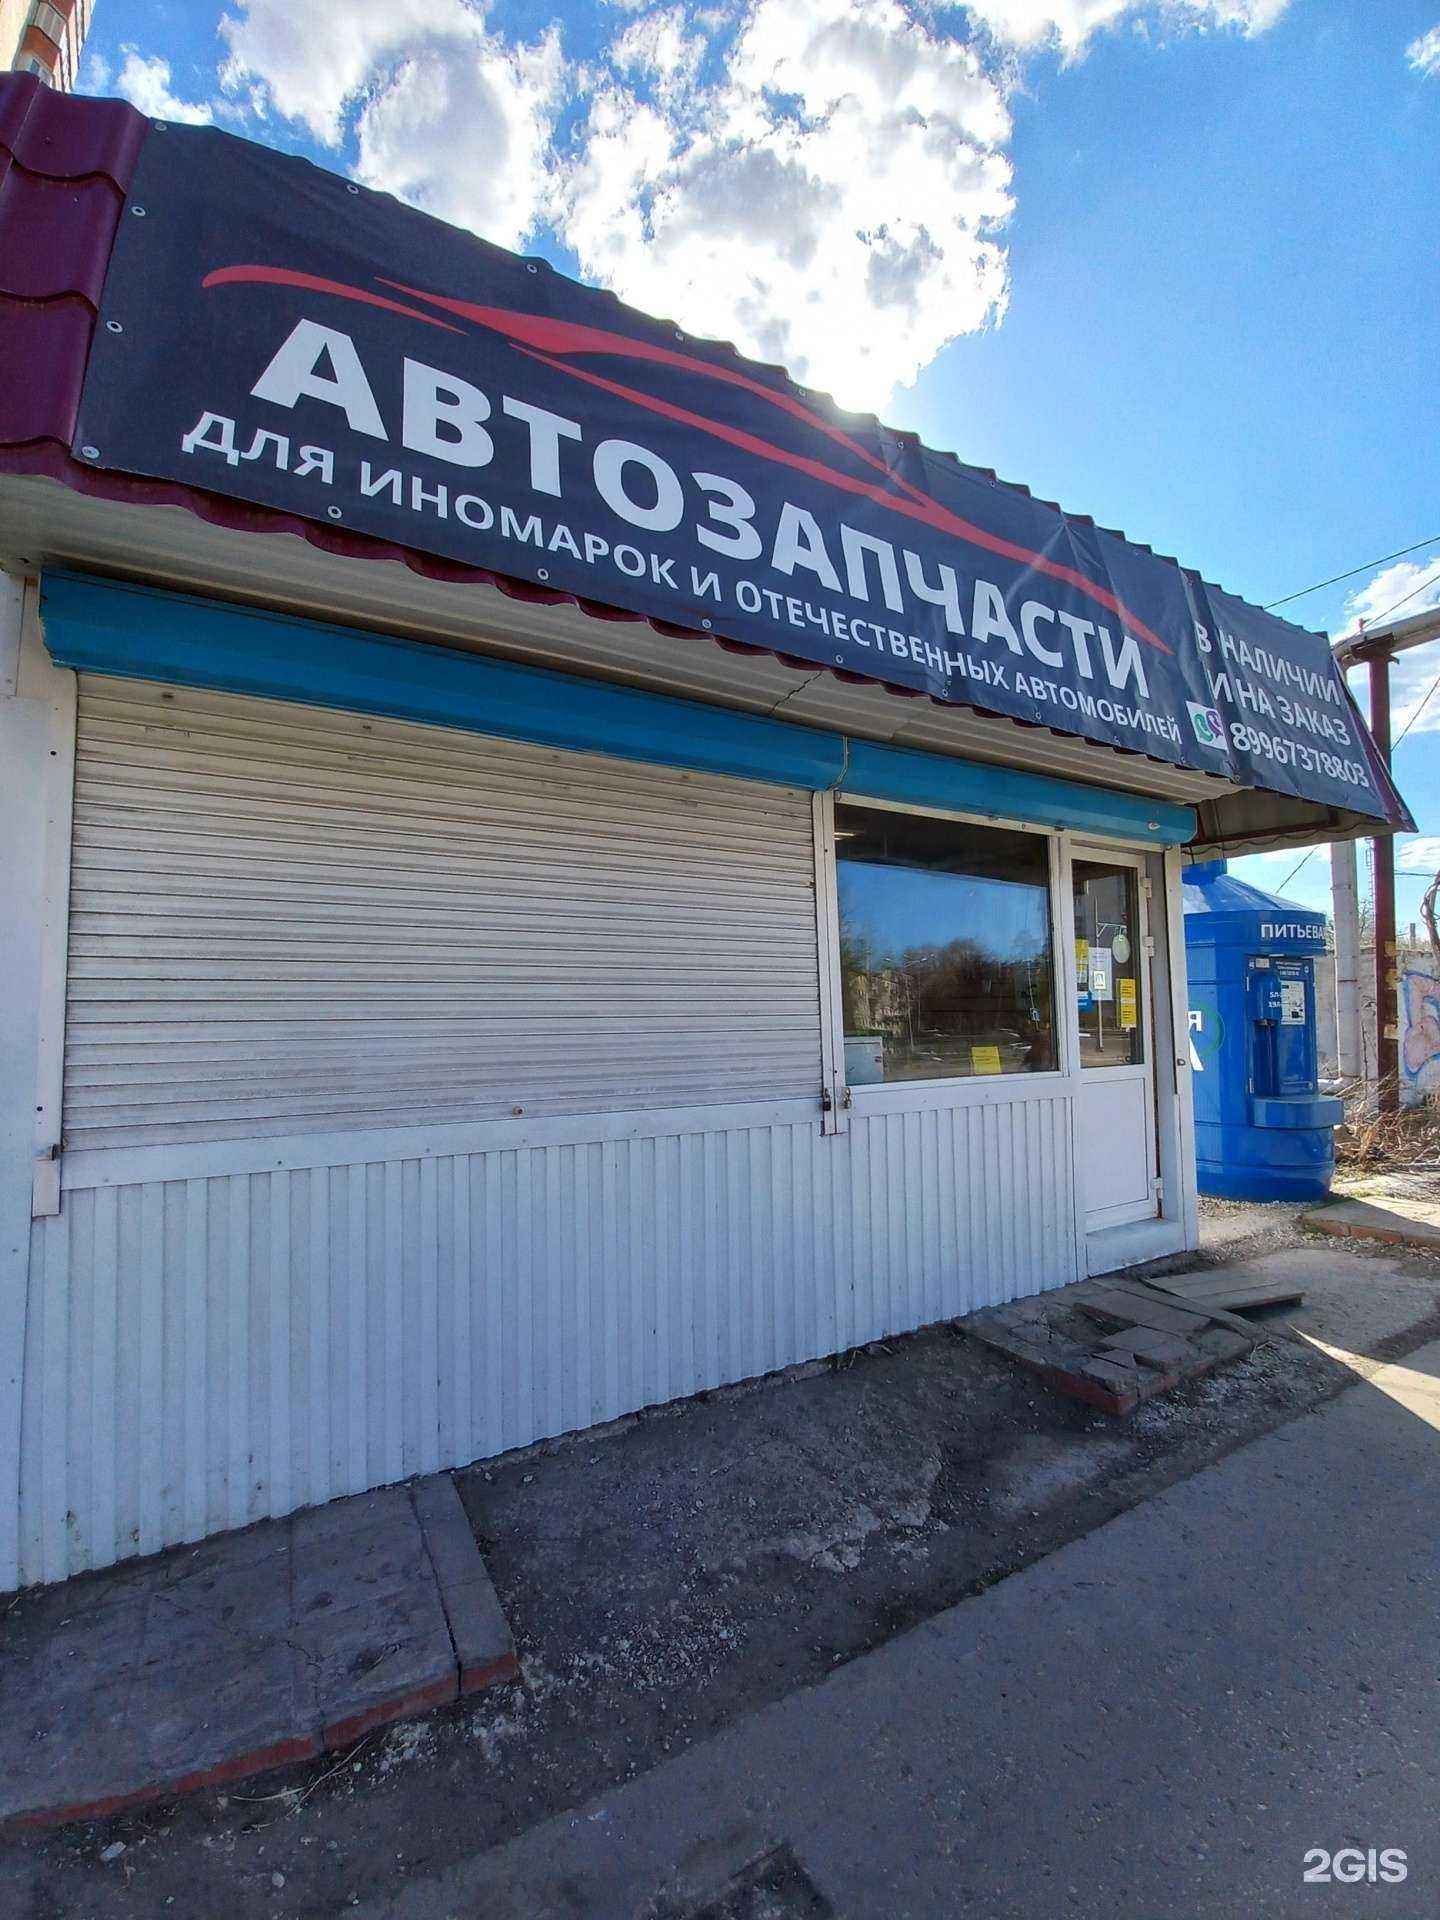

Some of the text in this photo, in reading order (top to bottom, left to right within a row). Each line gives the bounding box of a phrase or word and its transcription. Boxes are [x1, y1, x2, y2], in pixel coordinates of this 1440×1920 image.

[251, 319, 1149, 698] АВТОЗАПЧАСТИ
[181, 411, 1183, 745] ДЛЯ ИНОМАРОК И ОТЕЧЕСТВЕННЫХ АВТОМОБИЛЕЙ
[1194, 620, 1341, 706] В НАЛИЧИИ
[1207, 670, 1350, 746] И НА ЗАКАЗ
[1230, 723, 1369, 788] 89967378803
[1261, 924, 1326, 940] ПИТЬЕВА
